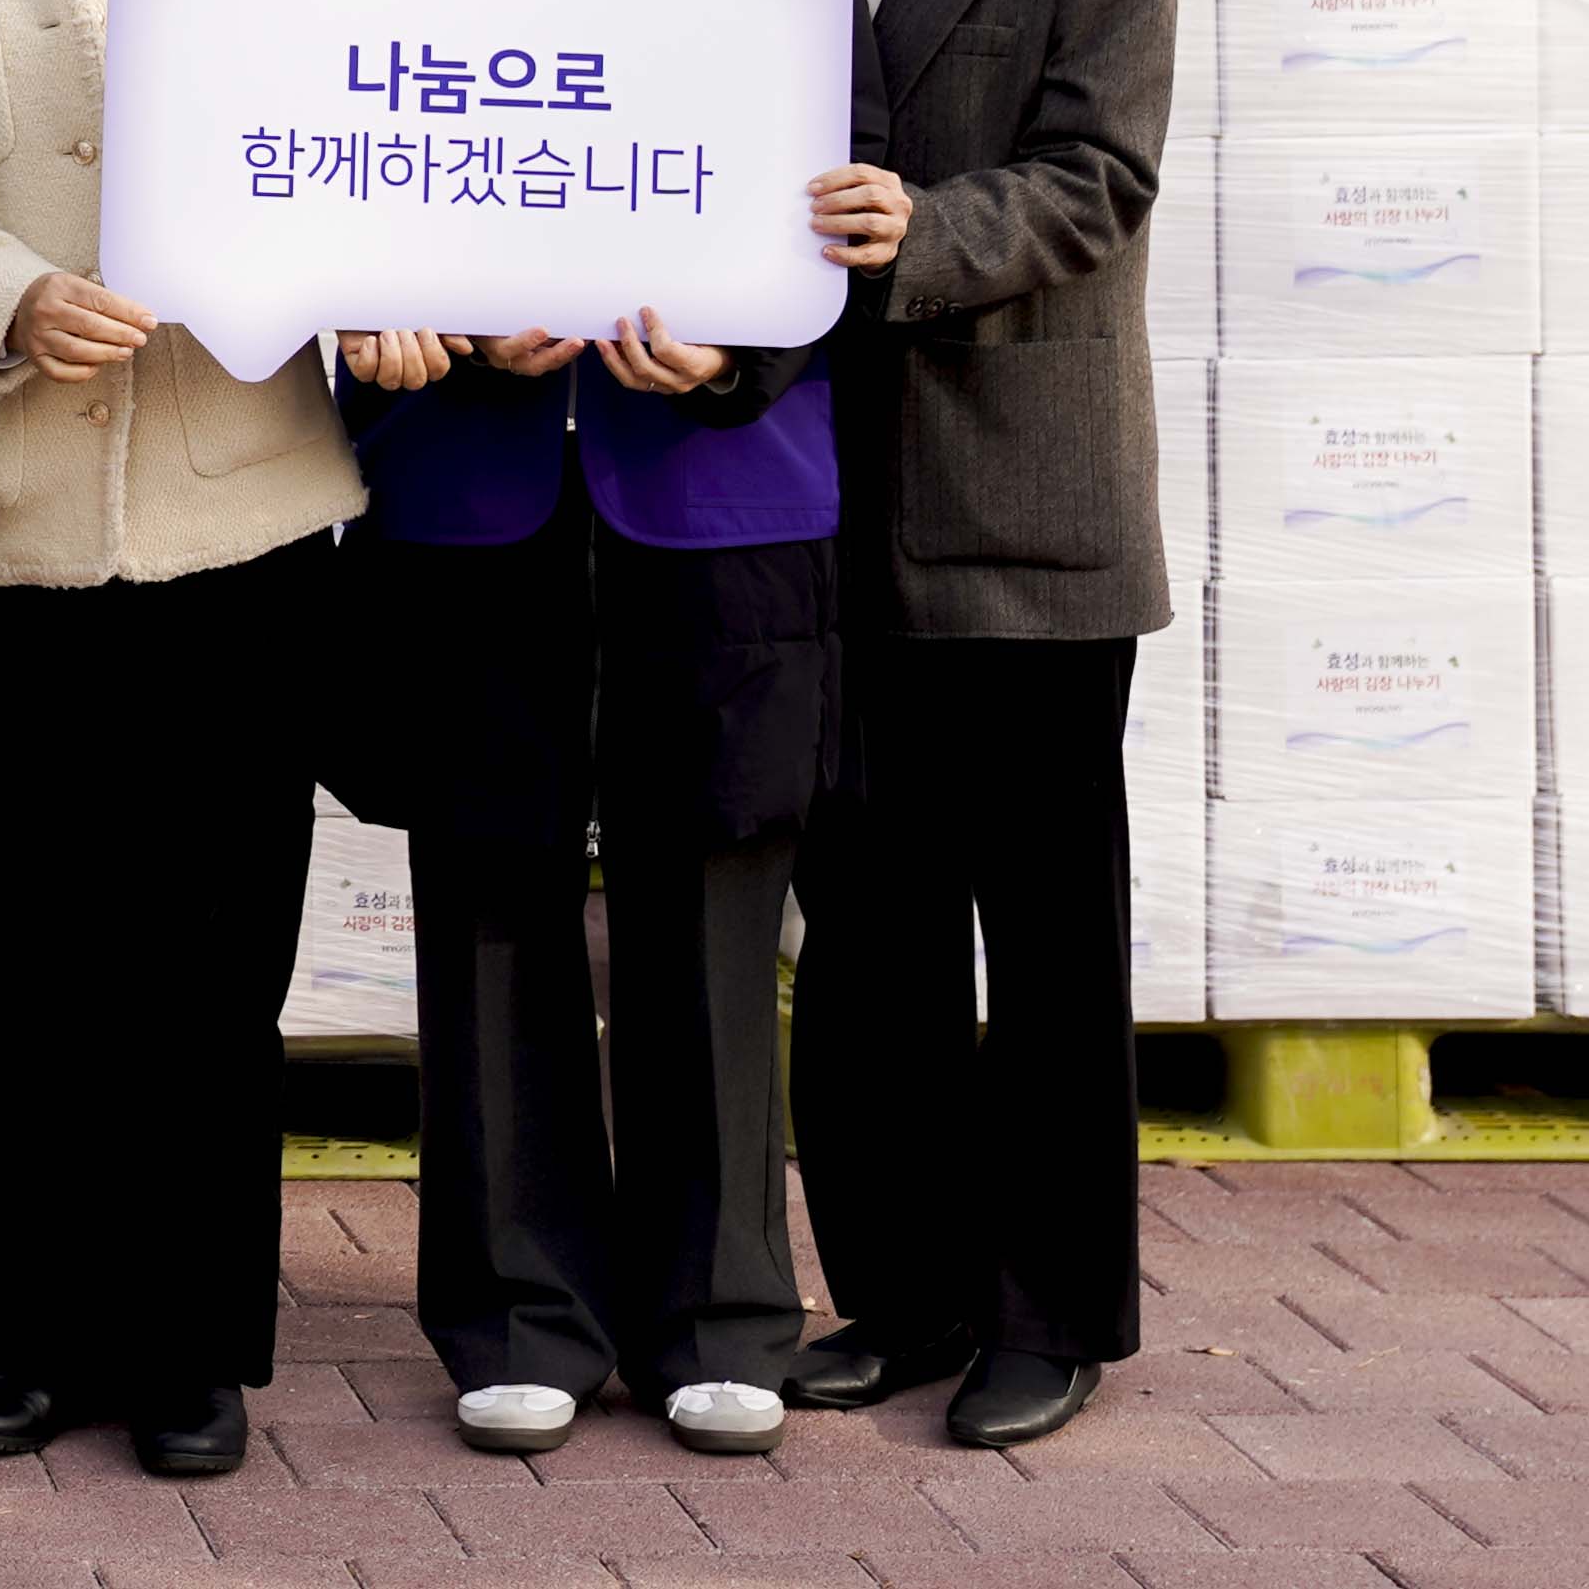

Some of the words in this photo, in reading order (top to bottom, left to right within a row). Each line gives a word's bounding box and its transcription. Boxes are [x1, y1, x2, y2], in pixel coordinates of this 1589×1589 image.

[348, 40, 612, 115] 나눔으로
[241, 126, 714, 215] 함께하겠습니다
[343, 915, 386, 932] 사랑의
[353, 890, 401, 910] 효성과
